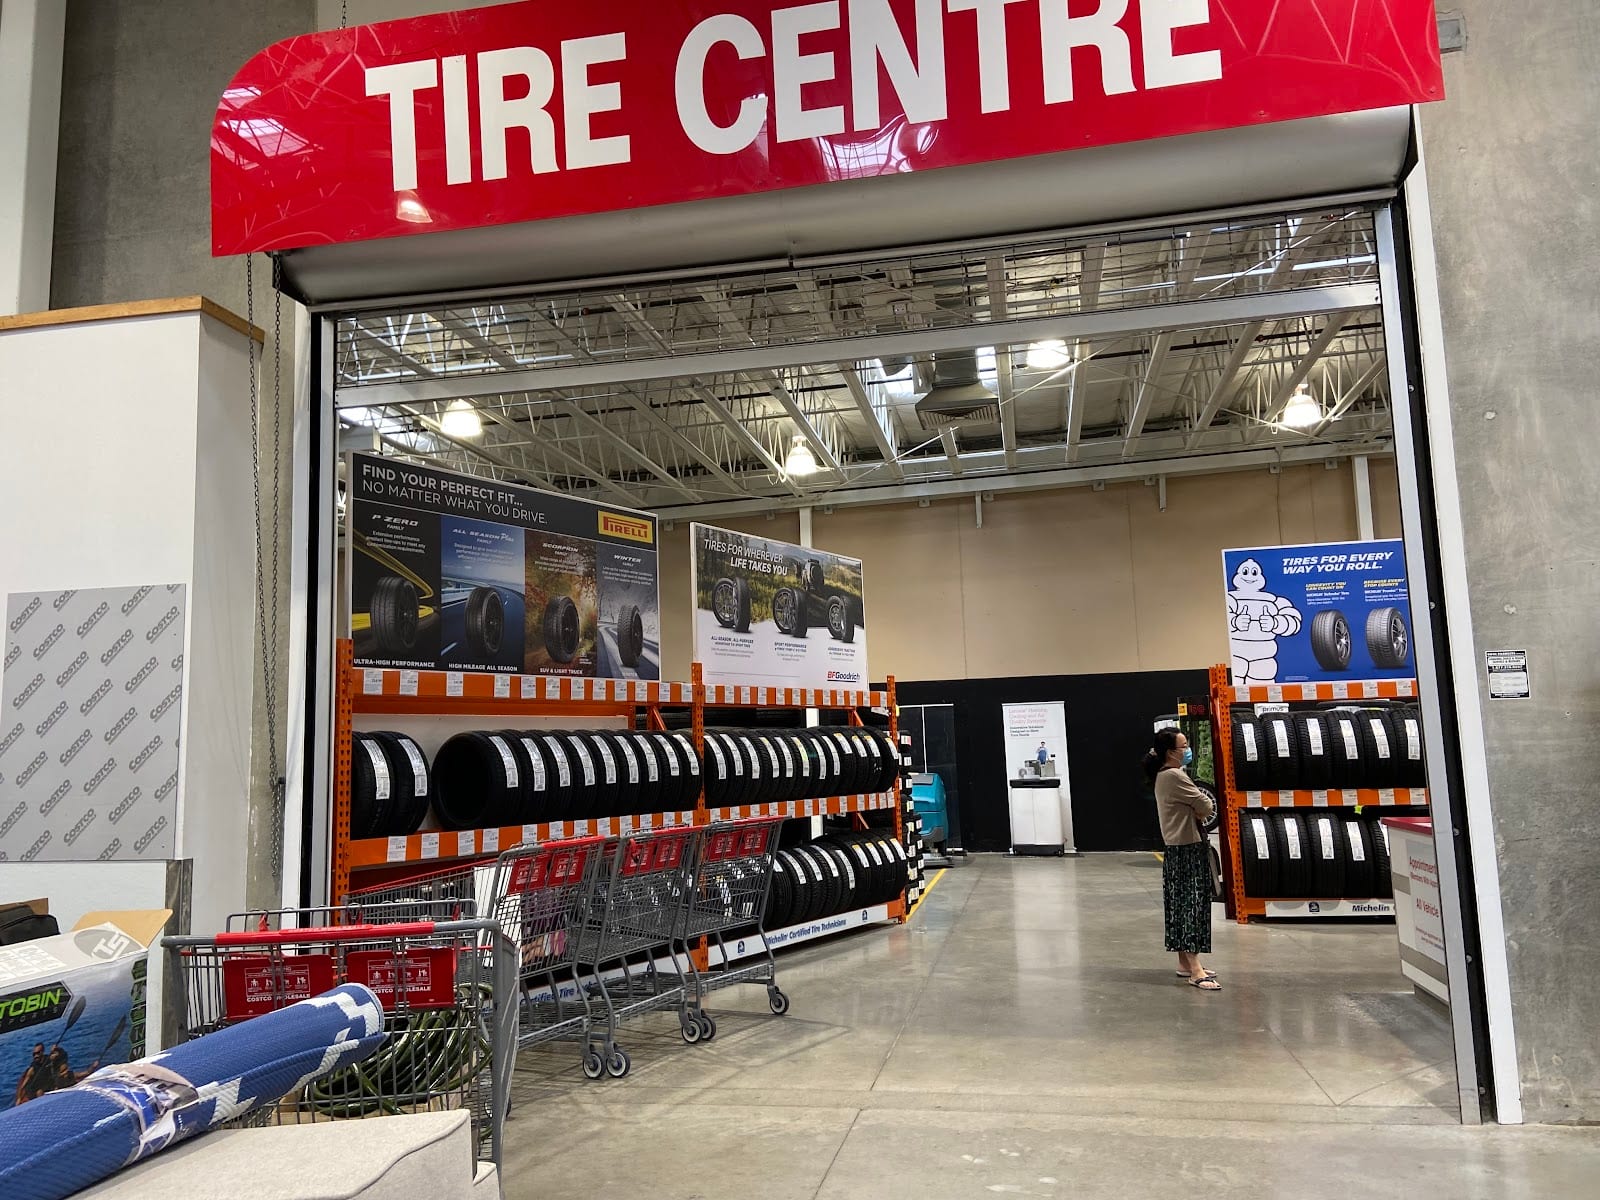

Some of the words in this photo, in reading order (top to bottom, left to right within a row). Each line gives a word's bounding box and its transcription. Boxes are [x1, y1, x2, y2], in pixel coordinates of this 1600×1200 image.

[365, 31, 632, 192] TIRE
[674, 0, 1223, 156] CENTRE
[363, 463, 396, 481] FIND
[400, 471, 437, 489] YOUR
[440, 480, 494, 500] PERFECT
[497, 491, 523, 506] FIT...
[363, 480, 384, 494] NO
[388, 484, 441, 504] MATTER
[444, 494, 481, 512] WHAT
[485, 502, 509, 517] YOU
[512, 507, 548, 524] DRIVE.
[383, 516, 419, 526] ZERO
[469, 530, 500, 540] SEASON
[603, 516, 648, 538] PIRELLI
[542, 542, 579, 552] SCORPION
[614, 554, 641, 562] WINTER
[704, 538, 726, 553] TIRES
[727, 543, 743, 556] FOR
[744, 547, 784, 563] WHEREVER
[1282, 557, 1318, 567] TIRES
[1319, 555, 1348, 564] FOR
[1348, 551, 1394, 562] EVERY
[730, 556, 747, 569] LIFE
[748, 560, 772, 574] TAKES
[772, 564, 788, 576] YOU
[1283, 565, 1314, 575] WAY
[1316, 563, 1344, 573] YOU
[1345, 561, 1383, 571] ROLL.
[10, 597, 40, 630] COSTCO
[77, 601, 107, 635] COSTCO
[146, 606, 178, 641] COSTCO
[33, 624, 63, 657] COSTCO
[100, 629, 132, 663] COSTCO
[56, 651, 86, 685] COSTCO
[125, 657, 157, 691] COSTCO
[353, 658, 391, 666] ULTRA-HIGH
[391, 660, 435, 668] PERFORMANCE
[827, 671, 860, 681] BFGoodrich
[13, 673, 43, 707] COSTCO
[80, 679, 111, 713] COSTCO
[150, 684, 182, 719] COSTCO
[36, 701, 67, 735] COSTCO
[104, 707, 136, 742] COSTCO
[60, 729, 90, 763] COSTCO
[128, 735, 161, 770] COSTCO
[16, 751, 46, 785] COSTCO
[83, 757, 115, 792] COSTCO
[39, 779, 70, 814] COSTCO
[108, 786, 140, 821] COSTCO
[64, 808, 94, 843] COSTCO
[133, 815, 166, 851] COSTCO
[1352, 904, 1390, 912] Michelin
[789, 926, 811, 940] Certified
[811, 925, 820, 934] Tire
[821, 919, 847, 931] Technicians
[246, 995, 272, 1003] COSTCO
[559, 987, 575, 998] Tire
